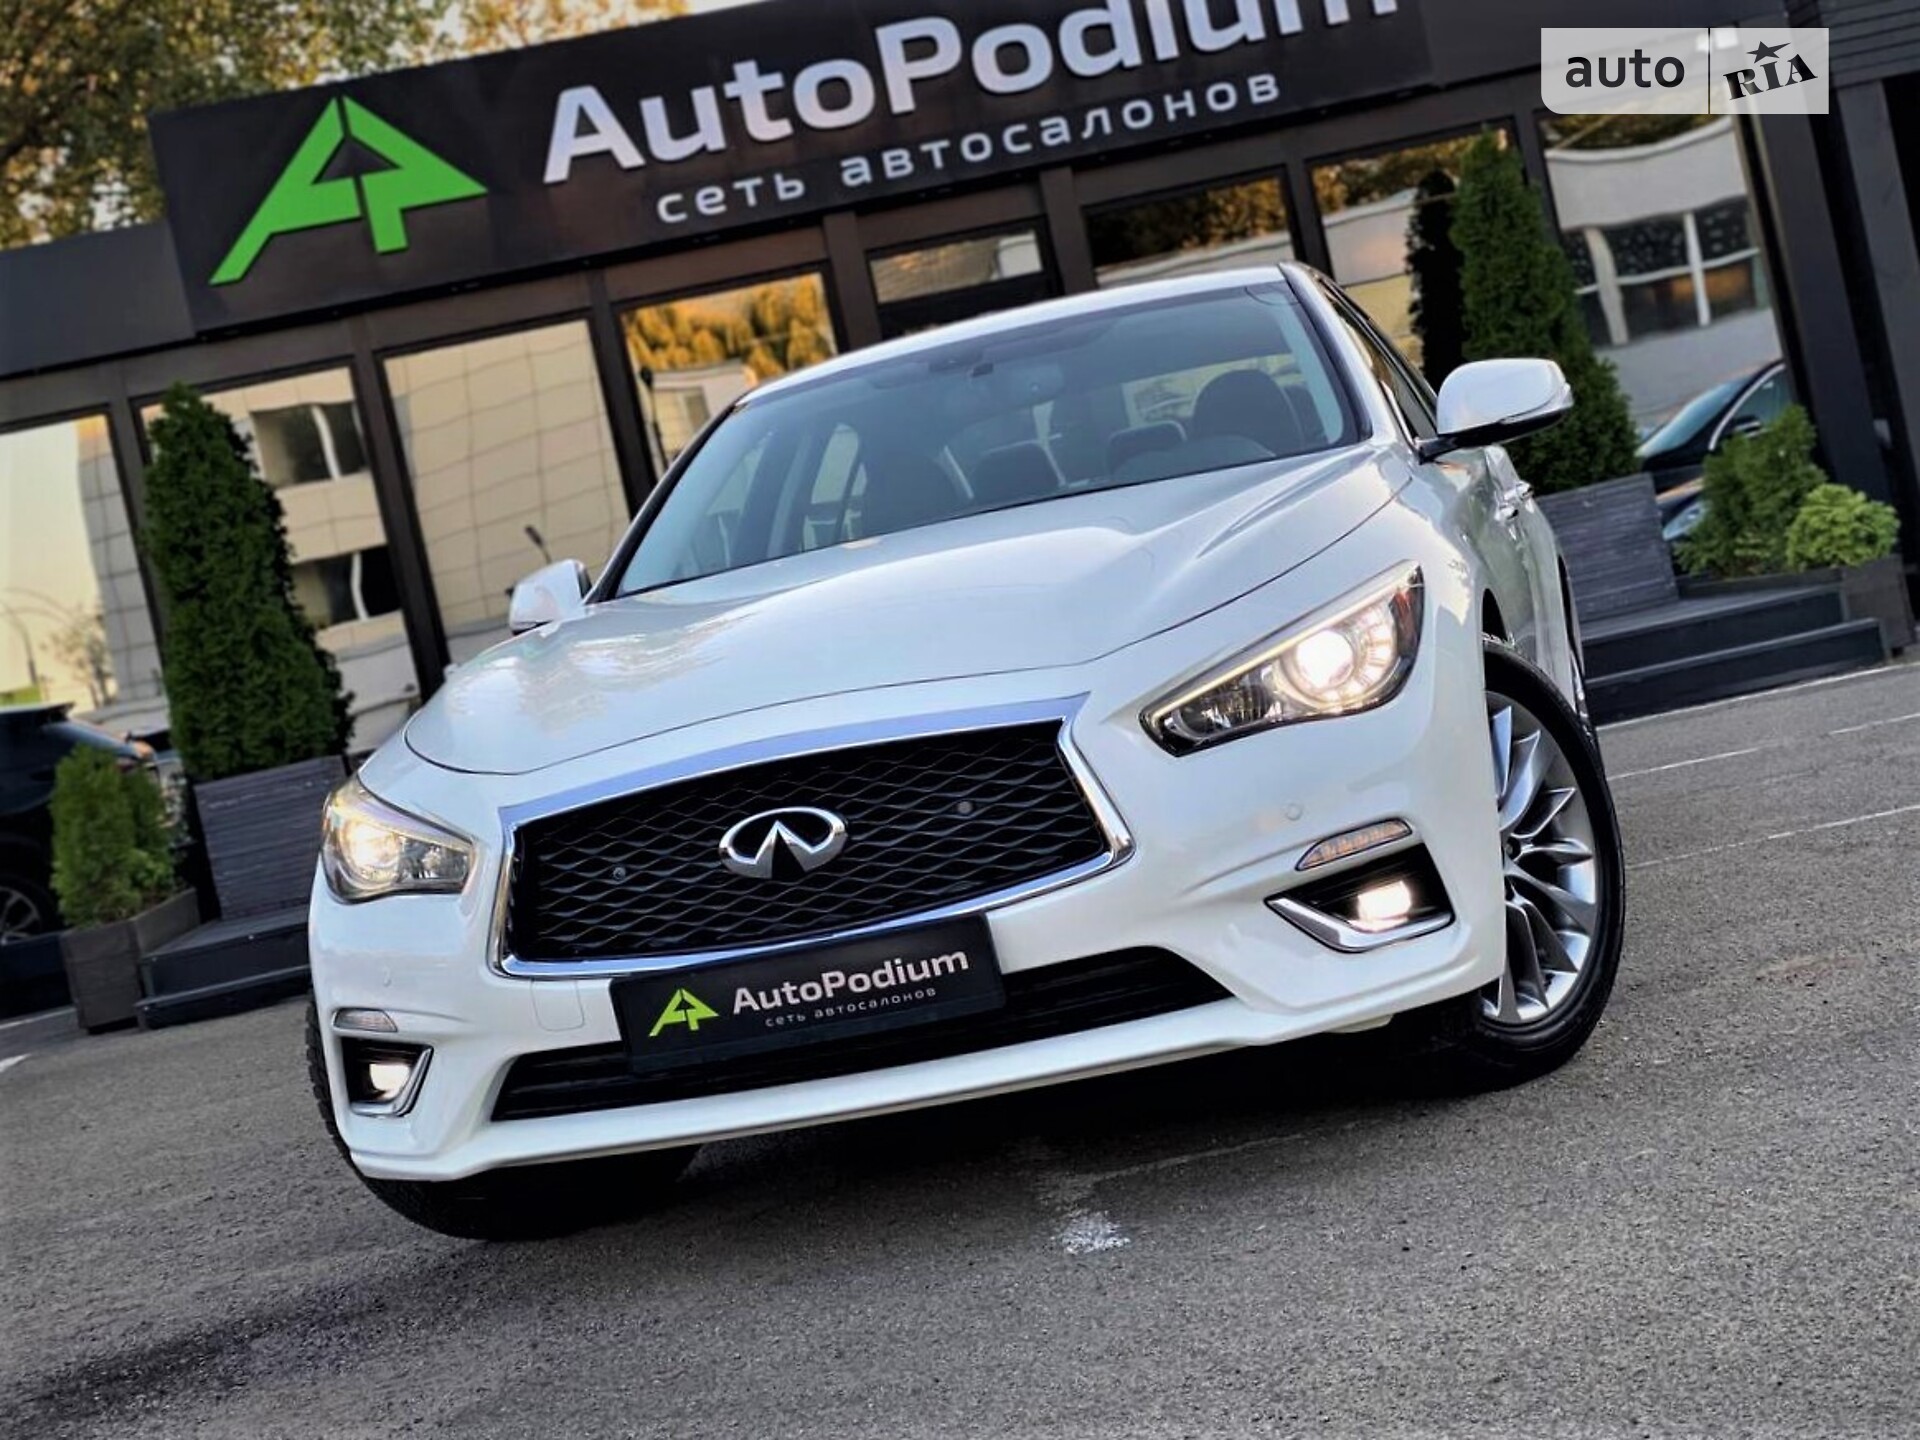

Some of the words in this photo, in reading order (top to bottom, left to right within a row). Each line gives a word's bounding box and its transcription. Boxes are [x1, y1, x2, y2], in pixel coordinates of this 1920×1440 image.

[657, 172, 806, 224] сеть
[841, 72, 1281, 188] автосалонов
[733, 951, 969, 1014] AutoPodium
[764, 1012, 807, 1028] сеть
[814, 988, 937, 1019] автосалонов
